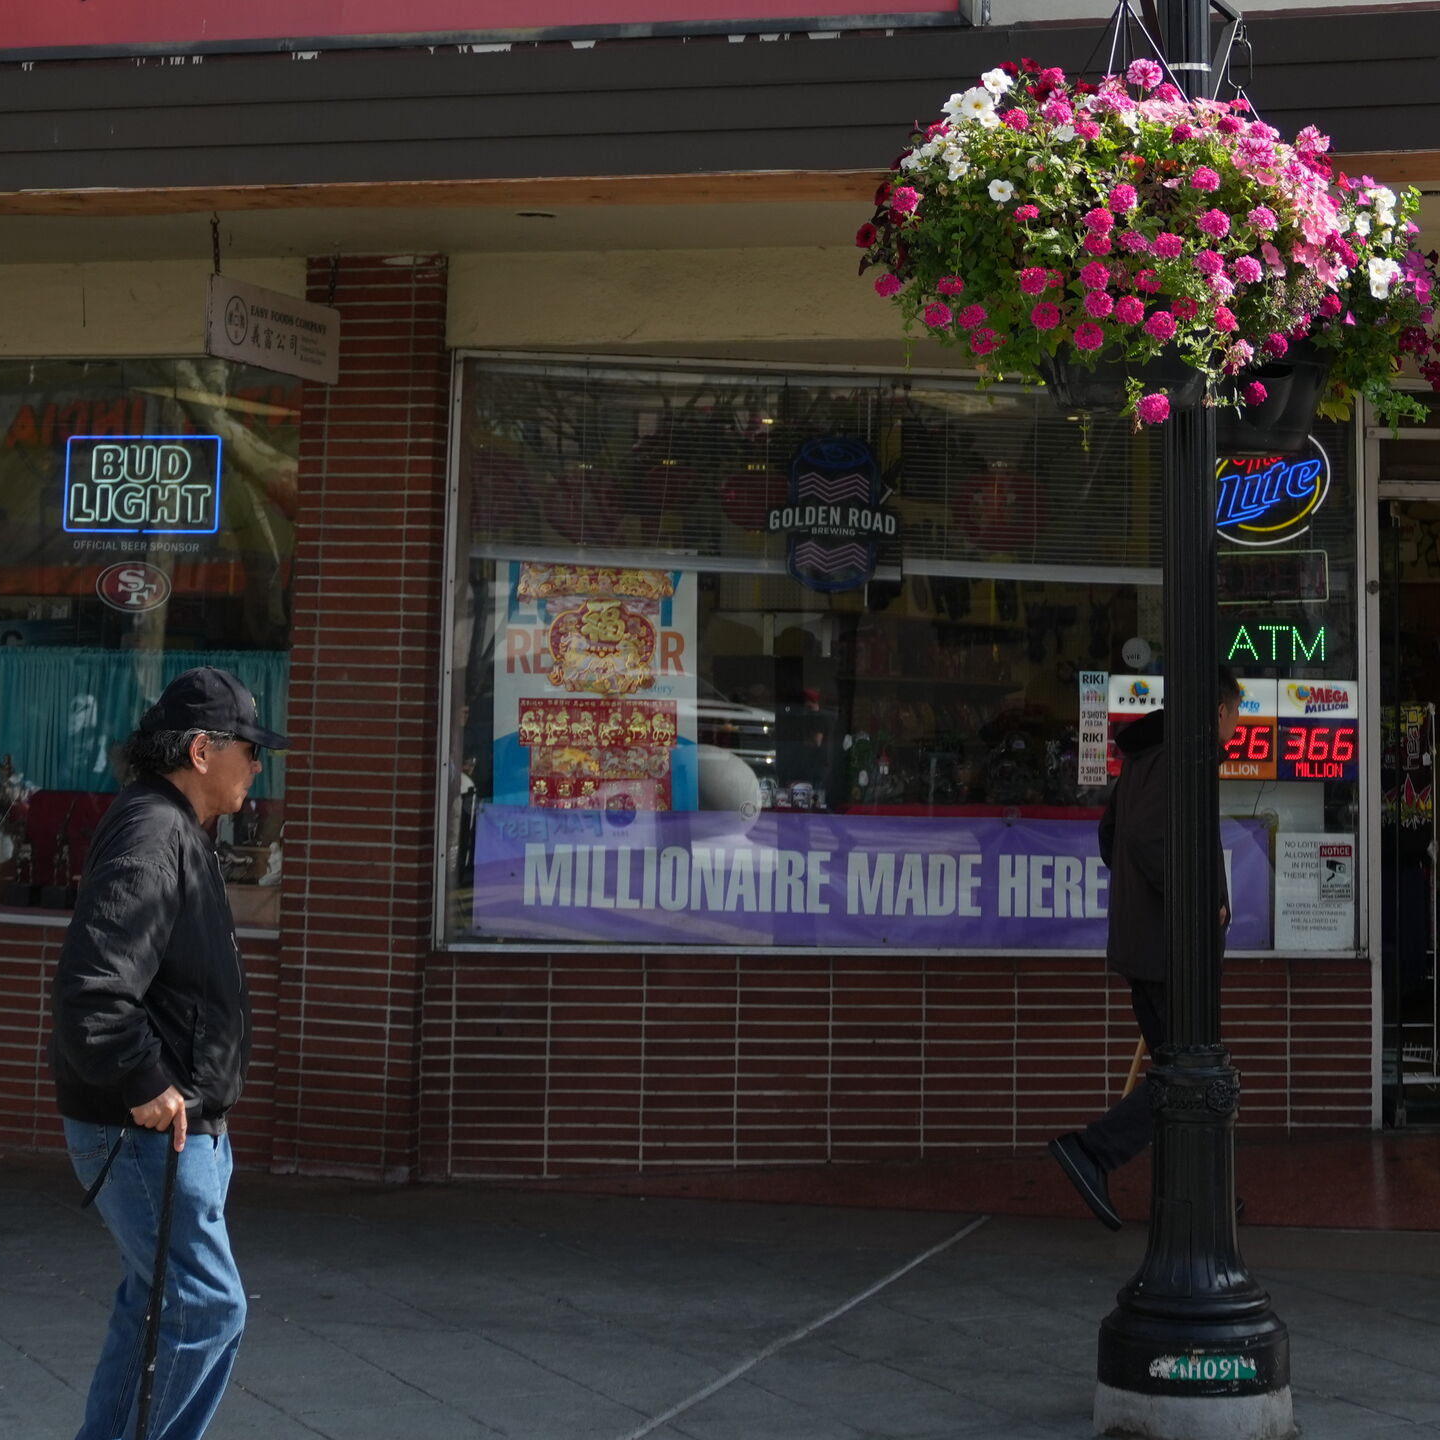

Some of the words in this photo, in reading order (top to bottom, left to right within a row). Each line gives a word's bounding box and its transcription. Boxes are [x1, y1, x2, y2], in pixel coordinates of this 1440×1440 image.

[295, 317, 327, 335] COMPANY
[92, 444, 191, 484] BUD
[70, 482, 211, 523] LIGHT
[769, 506, 841, 530] GOLDEN
[848, 507, 896, 535] ROAD
[811, 527, 856, 536] BREWING
[73, 539, 117, 551] OFFICIAL
[120, 540, 147, 551] BEER
[149, 541, 200, 553] SPONSOR
[1227, 624, 1326, 662] ATM
[1082, 675, 1104, 684] RIKI
[1309, 686, 1348, 704] MEGA
[1087, 711, 1106, 719] SHOTS
[1082, 733, 1104, 743] RIKI
[1283, 727, 1355, 761] 366
[1086, 766, 1105, 774] SHOTS
[1296, 762, 1344, 778] MILLION
[1321, 847, 1350, 856] NOTICE
[523, 843, 831, 914] MILLIONAIRE
[846, 852, 982, 917] MADE
